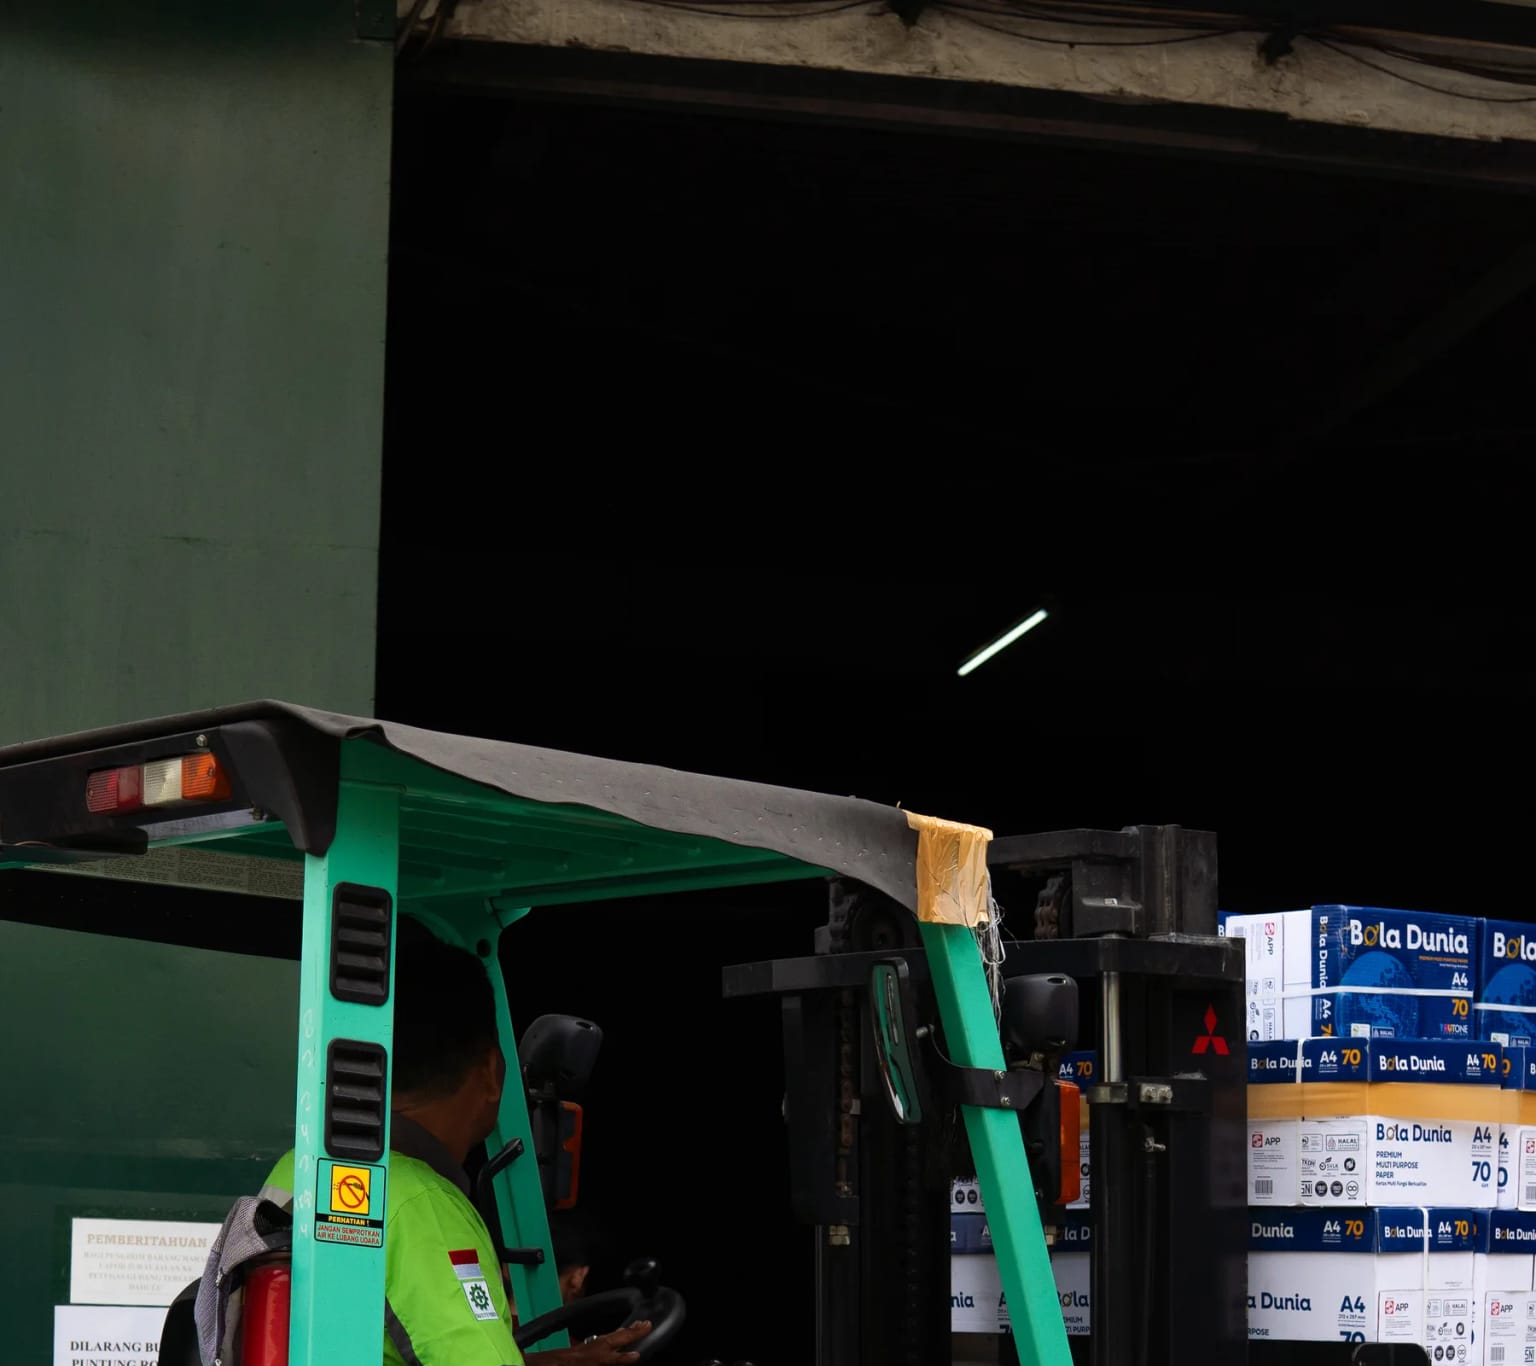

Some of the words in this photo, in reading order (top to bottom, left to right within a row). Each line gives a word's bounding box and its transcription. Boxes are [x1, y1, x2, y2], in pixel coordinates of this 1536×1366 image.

[1319, 916, 1329, 948] Bola
[1350, 919, 1401, 949] Bola
[1407, 924, 1469, 954] Dunia
[1493, 932, 1536, 961] Bola
[1319, 950, 1329, 988] Dunia
[1452, 971, 1468, 987] A4
[1322, 999, 1332, 1019] A4
[1451, 999, 1469, 1017] 70
[1321, 1023, 1332, 1037] 7
[1251, 1057, 1277, 1069] Bola
[1279, 1056, 1312, 1068] Duia
[1320, 1050, 1337, 1063] A4
[1341, 1048, 1361, 1065] 70
[1380, 1055, 1408, 1071] Bola
[1410, 1055, 1446, 1072] Dunia
[1466, 1054, 1480, 1067] A4
[1481, 1053, 1497, 1069] 70
[1059, 1063, 1074, 1076] A4
[1076, 1061, 1093, 1076] 70
[1264, 1136, 1281, 1146] APP
[1376, 1123, 1408, 1141] Bola
[1412, 1124, 1452, 1143] Dunia
[1473, 1126, 1492, 1143] A4
[1376, 1151, 1402, 1159] PREMIUM
[1376, 1161, 1392, 1169] MULTI
[1393, 1161, 1419, 1170] PURPOSE
[1472, 1161, 1491, 1182] 70
[1376, 1171, 1394, 1179] PAPER
[1252, 1222, 1294, 1238] Dunia
[1323, 1221, 1341, 1233] A4
[1345, 1220, 1364, 1236] 70
[1384, 1226, 1405, 1238] Bola
[1407, 1227, 1432, 1239] Duna
[1437, 1221, 1452, 1234] A4
[1454, 1220, 1469, 1236] 70
[1495, 1228, 1515, 1240] Bola
[1516, 1228, 1536, 1241] Duni
[87, 1233, 208, 1248] PEMBERITAHUAN
[1261, 1292, 1311, 1311] Dunia
[1340, 1296, 1366, 1313] A4
[1395, 1303, 1409, 1311] APP
[1500, 1305, 1513, 1313] APP
[71, 1341, 141, 1352] DILARANG
